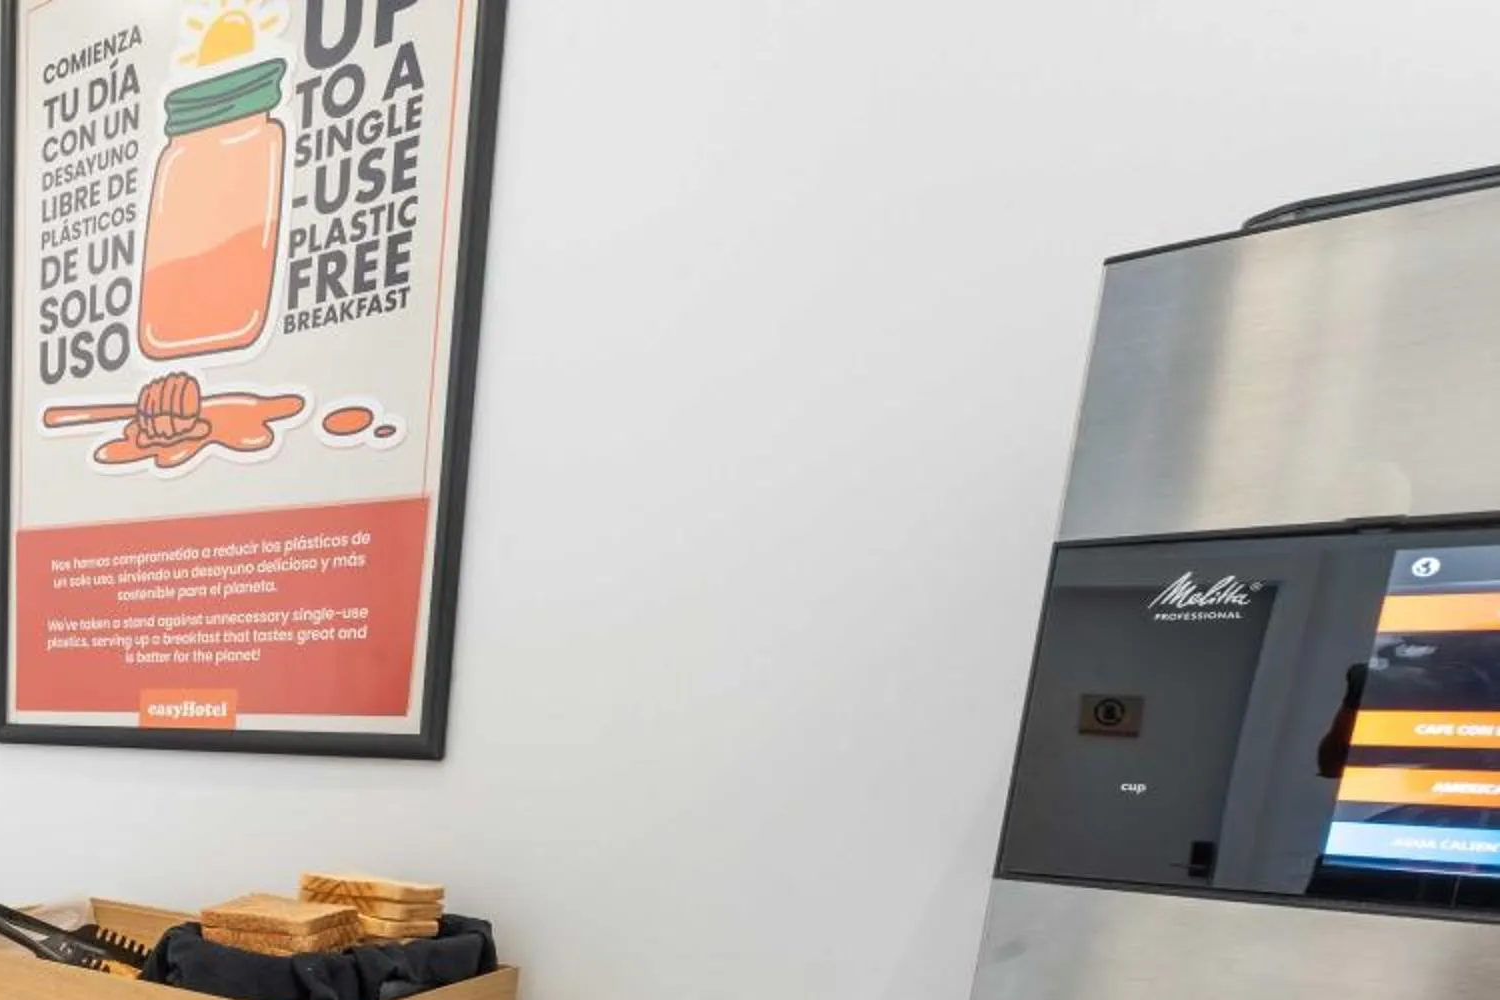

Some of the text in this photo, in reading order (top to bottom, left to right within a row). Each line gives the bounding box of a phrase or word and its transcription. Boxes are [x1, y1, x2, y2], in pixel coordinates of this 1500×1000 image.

[43, 24, 142, 85] COMIENZA
[43, 58, 140, 129] TU DÍA
[295, 41, 425, 129] TO A
[42, 103, 139, 163] CON UN
[294, 93, 424, 168] SINGLE
[42, 140, 139, 192] DESAYUNO
[292, 135, 420, 214] -USE
[41, 167, 138, 223] LIBRE DE
[41, 203, 137, 251] PLÁSTICOS
[288, 195, 419, 259] PLASTIC
[40, 229, 135, 290] DE UN
[287, 229, 413, 310] FREE
[40, 276, 133, 334] SOLO
[283, 284, 411, 334] BREAKFAST
[40, 322, 131, 386] USO
[51, 530, 371, 571] Nos hemos comprometido a reducir los plásticos de
[53, 577, 67, 589] un
[69, 574, 91, 587] solo
[118, 569, 170, 584] sirviendo
[173, 567, 188, 579] un
[191, 562, 254, 580] desayuno
[257, 556, 317, 573] delicioso
[320, 557, 330, 573] y
[333, 551, 366, 567] más
[117, 579, 277, 601] sostenible para el planeta.
[1148, 571, 1252, 609] Melitta
[1154, 610, 1244, 621] PROFESSIONAL
[47, 606, 369, 632] We've taken a stand against unnecessary single-use
[92, 634, 133, 650] serving
[135, 635, 149, 649] up
[152, 635, 160, 645] a
[163, 630, 222, 645] breakfast
[223, 629, 250, 643] that
[253, 628, 293, 642] tastes
[297, 627, 334, 645] great
[338, 624, 368, 639] and
[125, 647, 261, 666] is better for the planet!
[147, 700, 229, 720] easyHotel
[1120, 783, 1147, 795] cup
